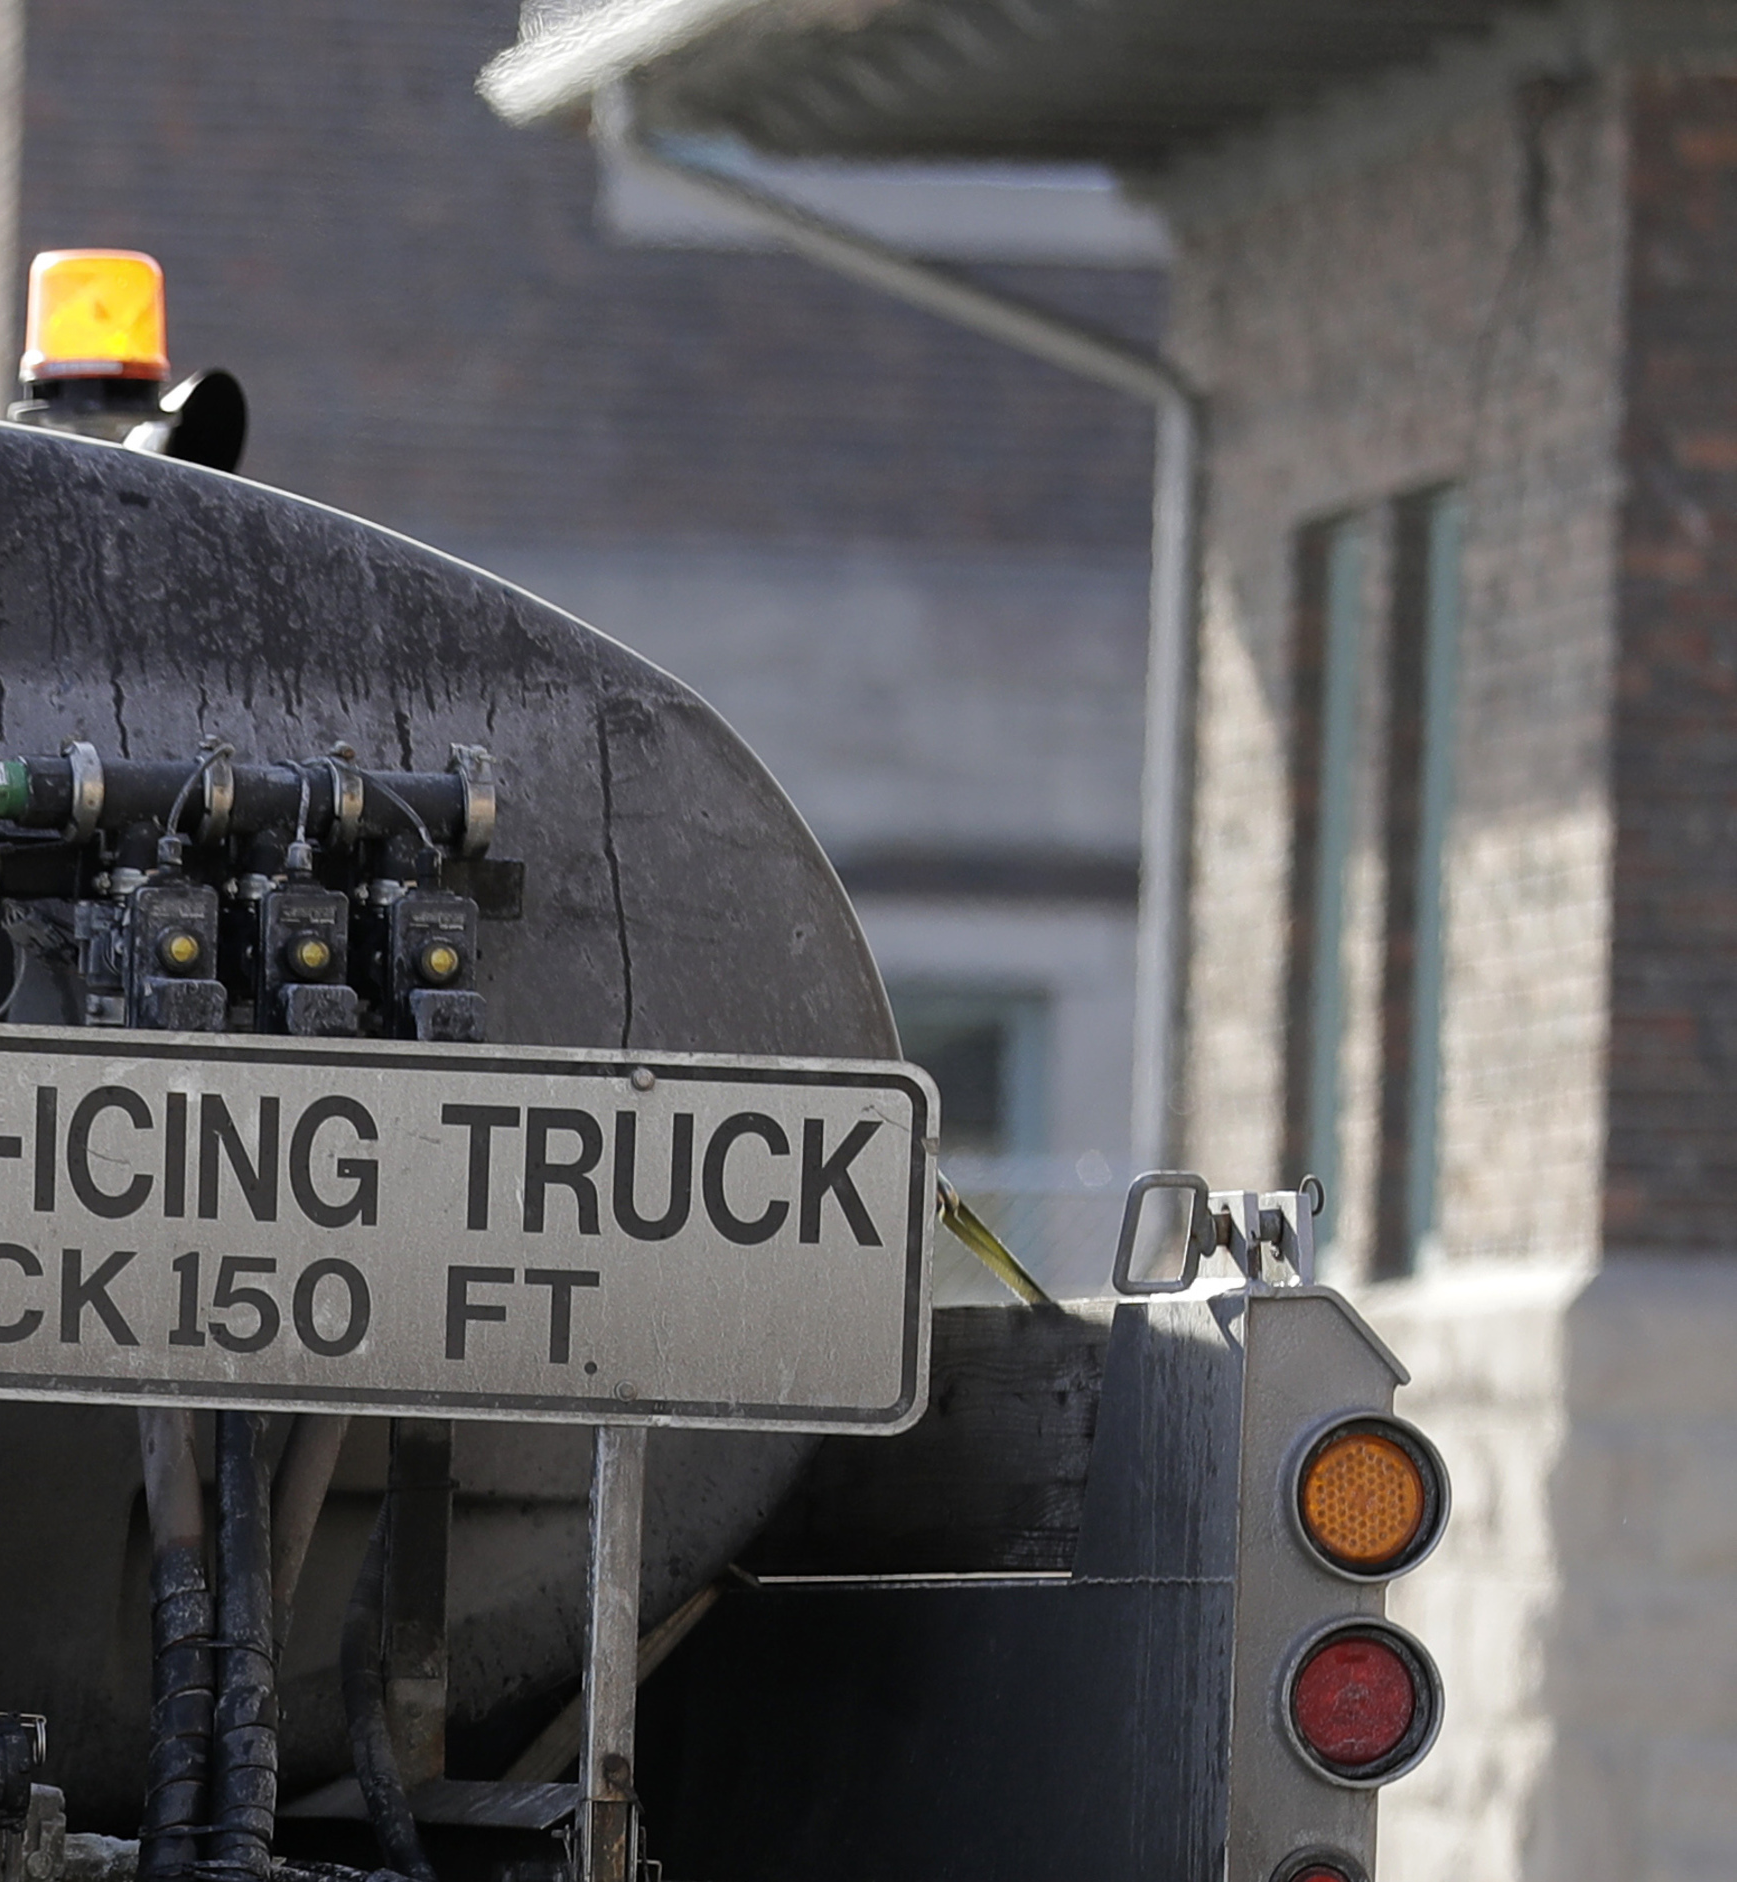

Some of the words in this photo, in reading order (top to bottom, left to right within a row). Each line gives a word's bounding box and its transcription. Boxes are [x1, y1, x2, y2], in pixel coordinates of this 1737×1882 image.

[440, 1103, 883, 1247] TRUCK
[167, 1250, 372, 1359] 150
[444, 1264, 601, 1378] FT.
